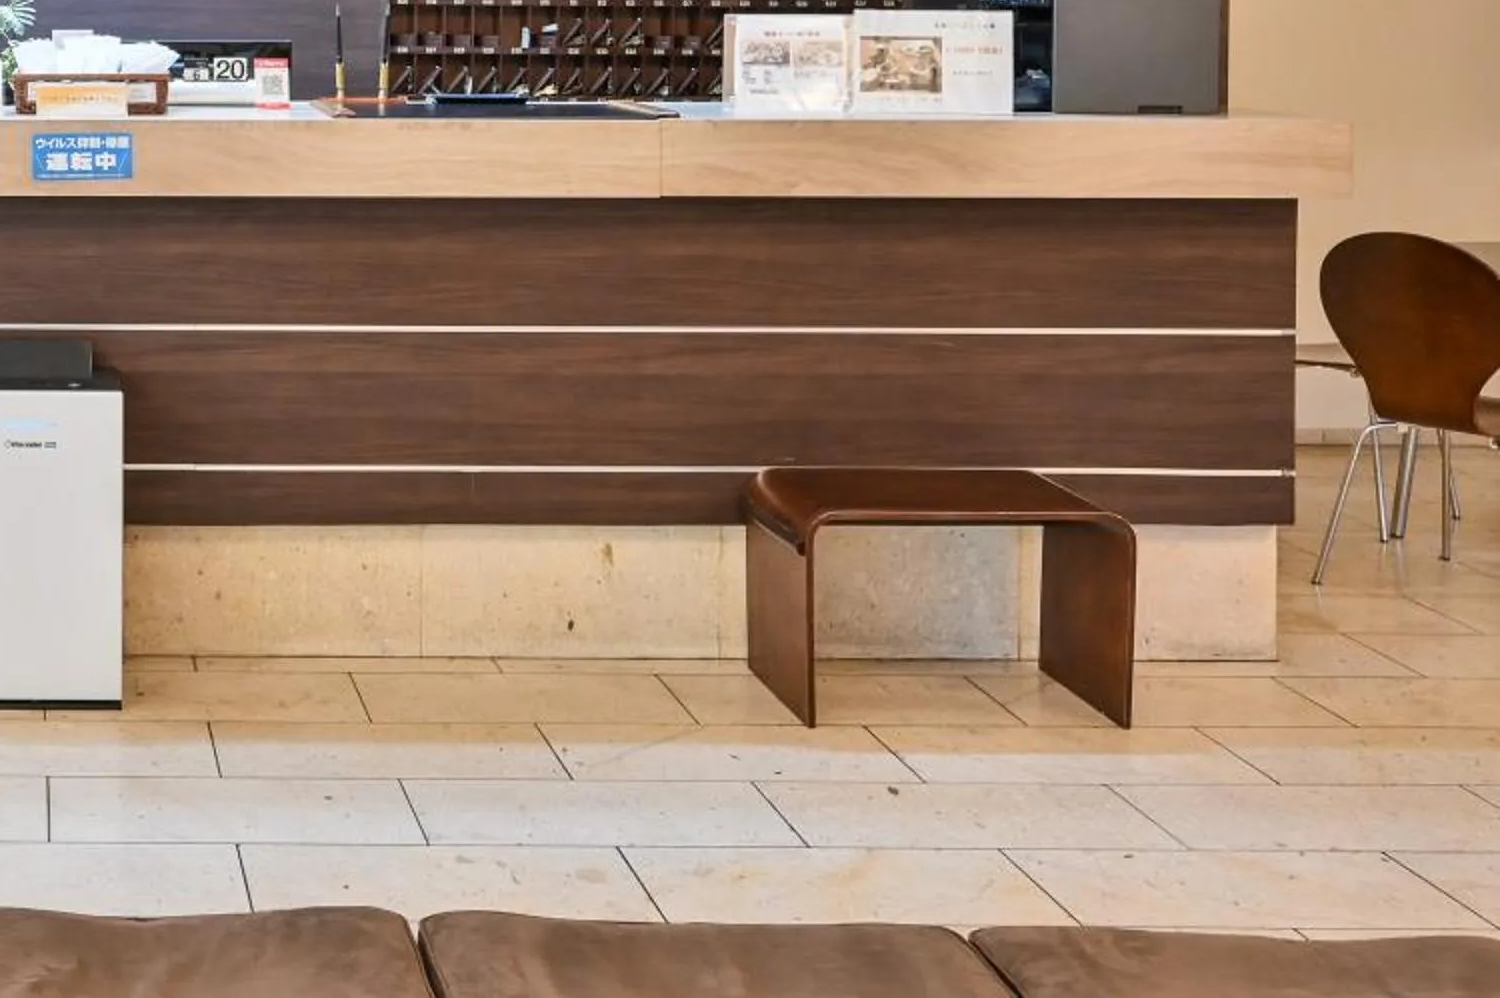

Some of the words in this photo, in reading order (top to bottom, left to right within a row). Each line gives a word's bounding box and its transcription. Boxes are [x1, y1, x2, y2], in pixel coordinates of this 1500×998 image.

[216, 59, 245, 79] 20
[45, 151, 117, 171] 運転中
